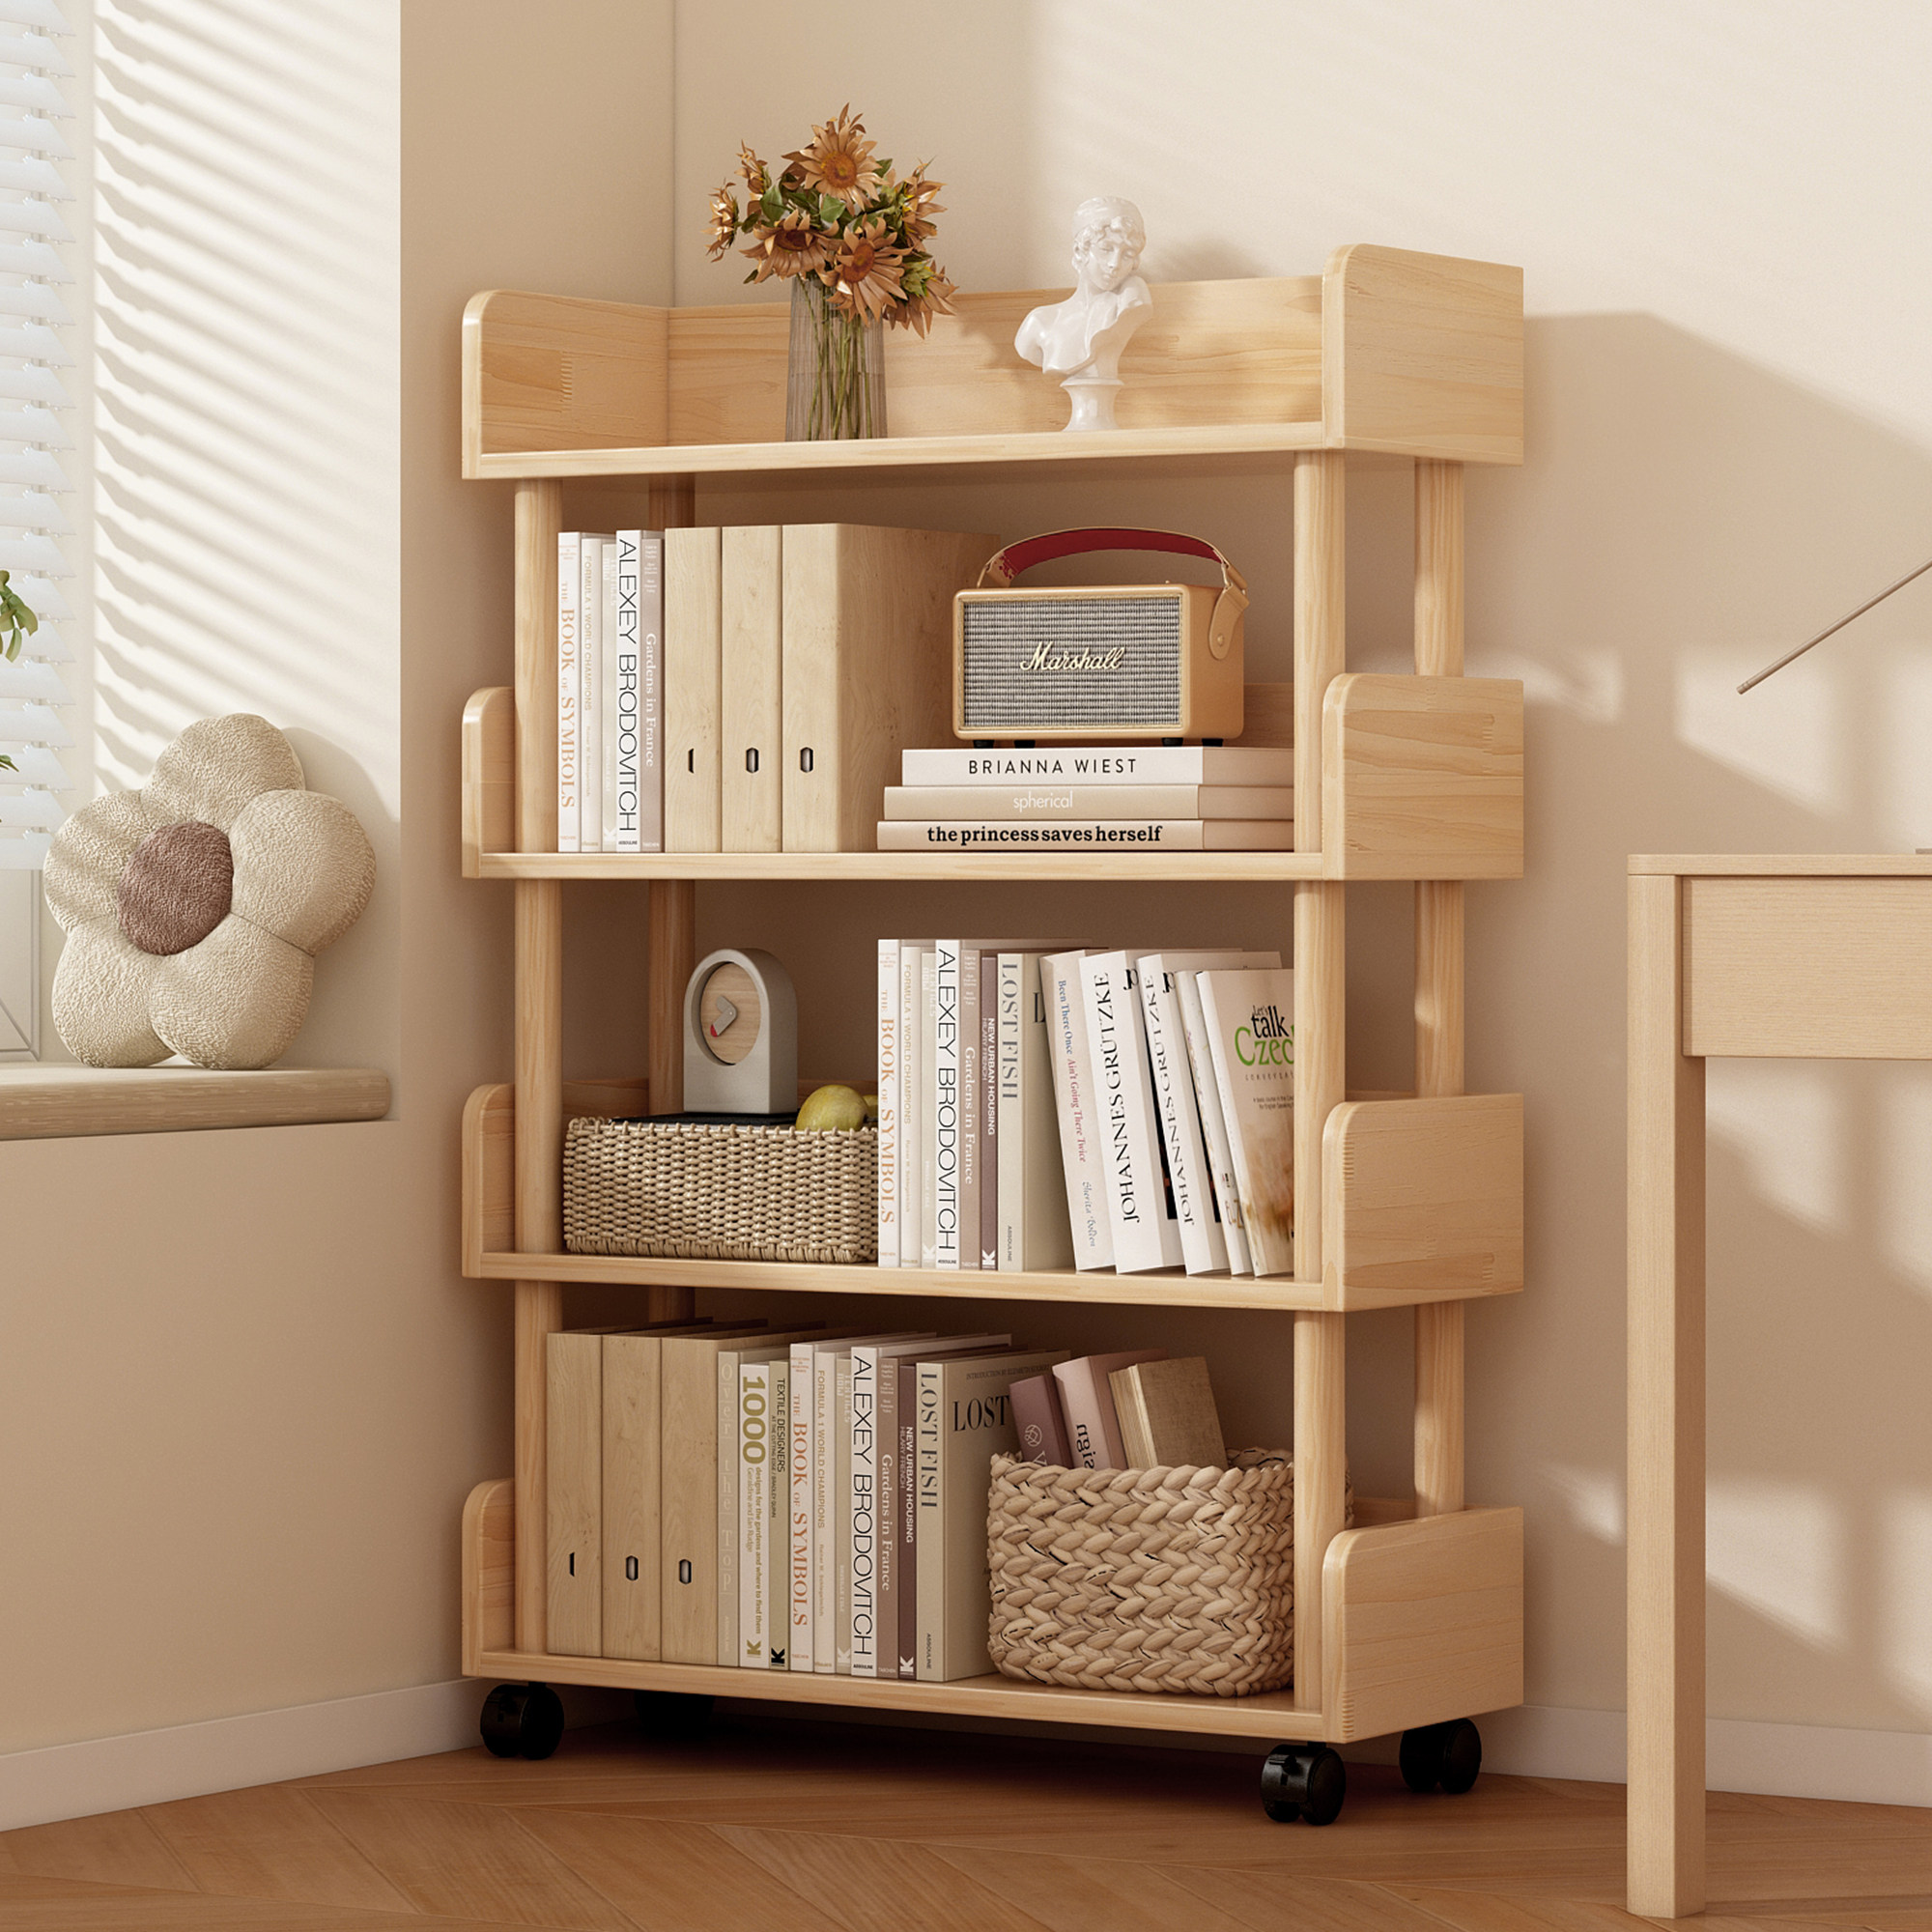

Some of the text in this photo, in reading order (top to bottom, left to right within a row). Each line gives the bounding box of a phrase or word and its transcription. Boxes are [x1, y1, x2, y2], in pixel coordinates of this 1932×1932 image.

[583, 555, 592, 603] FORMULA
[560, 609, 576, 672] BOOK
[583, 613, 592, 649] WORLD
[1020, 641, 1125, 670] Marshall
[561, 677, 568, 691] OF
[618, 539, 637, 831] ALEXEY BRODOVITCH
[645, 633, 657, 767] Gardens in France
[560, 696, 575, 808] SYMBOLS
[969, 758, 1137, 774] BRIANNA WIEST
[927, 825, 1162, 846] the princess saves herself
[1013, 790, 1073, 812] spherical
[1002, 963, 1018, 1100] LOST FISH
[1235, 1024, 1294, 1066] Czec
[1251, 1005, 1290, 1038] talk
[1252, 1005, 1268, 1016] Let's
[881, 1019, 895, 1083] BOOK
[1059, 980, 1087, 1162] Been There Once Ain't Going There Twice
[881, 1089, 888, 1104] OF
[939, 949, 956, 1249] ALEXEY BRODOVITCH
[964, 1046, 976, 1184] Gardens in France
[1094, 972, 1141, 1224] JOHANNES GRÜTZKE
[881, 1108, 895, 1223] SYMBOLS
[1165, 1095, 1195, 1226] JOHANNES
[742, 1376, 766, 1464] 1000
[754, 1466, 763, 1495] designs
[777, 1378, 785, 1473] TEXTILE DESIGNERS
[921, 1373, 938, 1507] LOST FISH
[953, 1395, 1010, 1432] LOST
[792, 1422, 809, 1488] BOOK
[794, 1492, 801, 1507] OF
[853, 1355, 873, 1655] ALEXEY BRODOVITCH
[881, 1454, 894, 1591] Gardens in France
[792, 1512, 809, 1626] SYMBOLS
